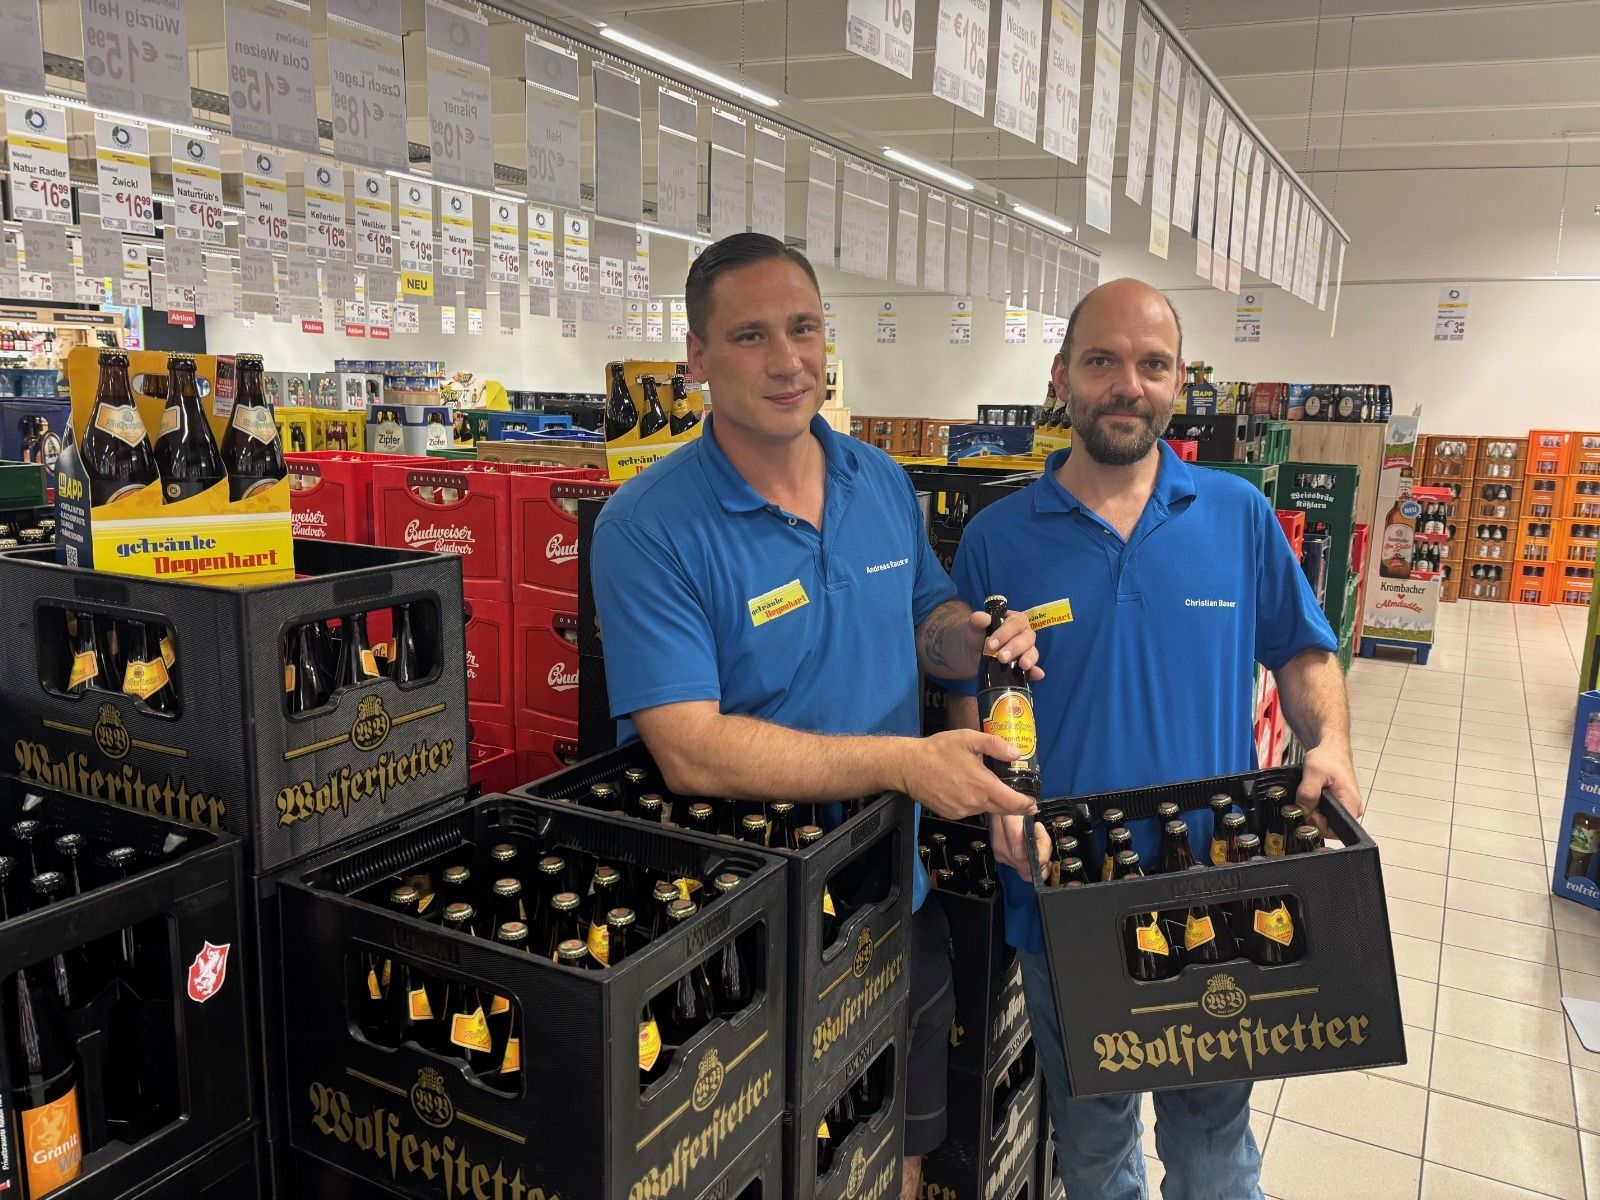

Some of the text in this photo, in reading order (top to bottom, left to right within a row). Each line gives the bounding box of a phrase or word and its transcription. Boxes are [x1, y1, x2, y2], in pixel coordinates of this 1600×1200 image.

[1006, 13, 1029, 41] Weizen
[13, 162, 67, 179] Natur Radler
[112, 176, 139, 189] Zwickl
[259, 201, 273, 211] Hell
[406, 279, 428, 291] NEU
[171, 313, 193, 322] Aktion
[303, 323, 322, 332] Aktion
[347, 327, 364, 335] Aktion
[371, 329, 388, 337] Aktion
[378, 433, 401, 447] Zipfer
[428, 437, 446, 448] Zipfer
[66, 478, 83, 502] APP
[291, 509, 327, 527] weiser
[403, 518, 476, 549] Budweiser
[116, 535, 217, 558] getränke
[433, 541, 474, 556] Budvar
[153, 549, 278, 575] Degenhart
[1380, 581, 1426, 595] Krombacher
[751, 596, 784, 617] getränke
[1184, 598, 1218, 607] Christian
[1376, 600, 1424, 613] Almdudler
[1565, 881, 1600, 900] volvic
[32, 1134, 79, 1166] Granit
